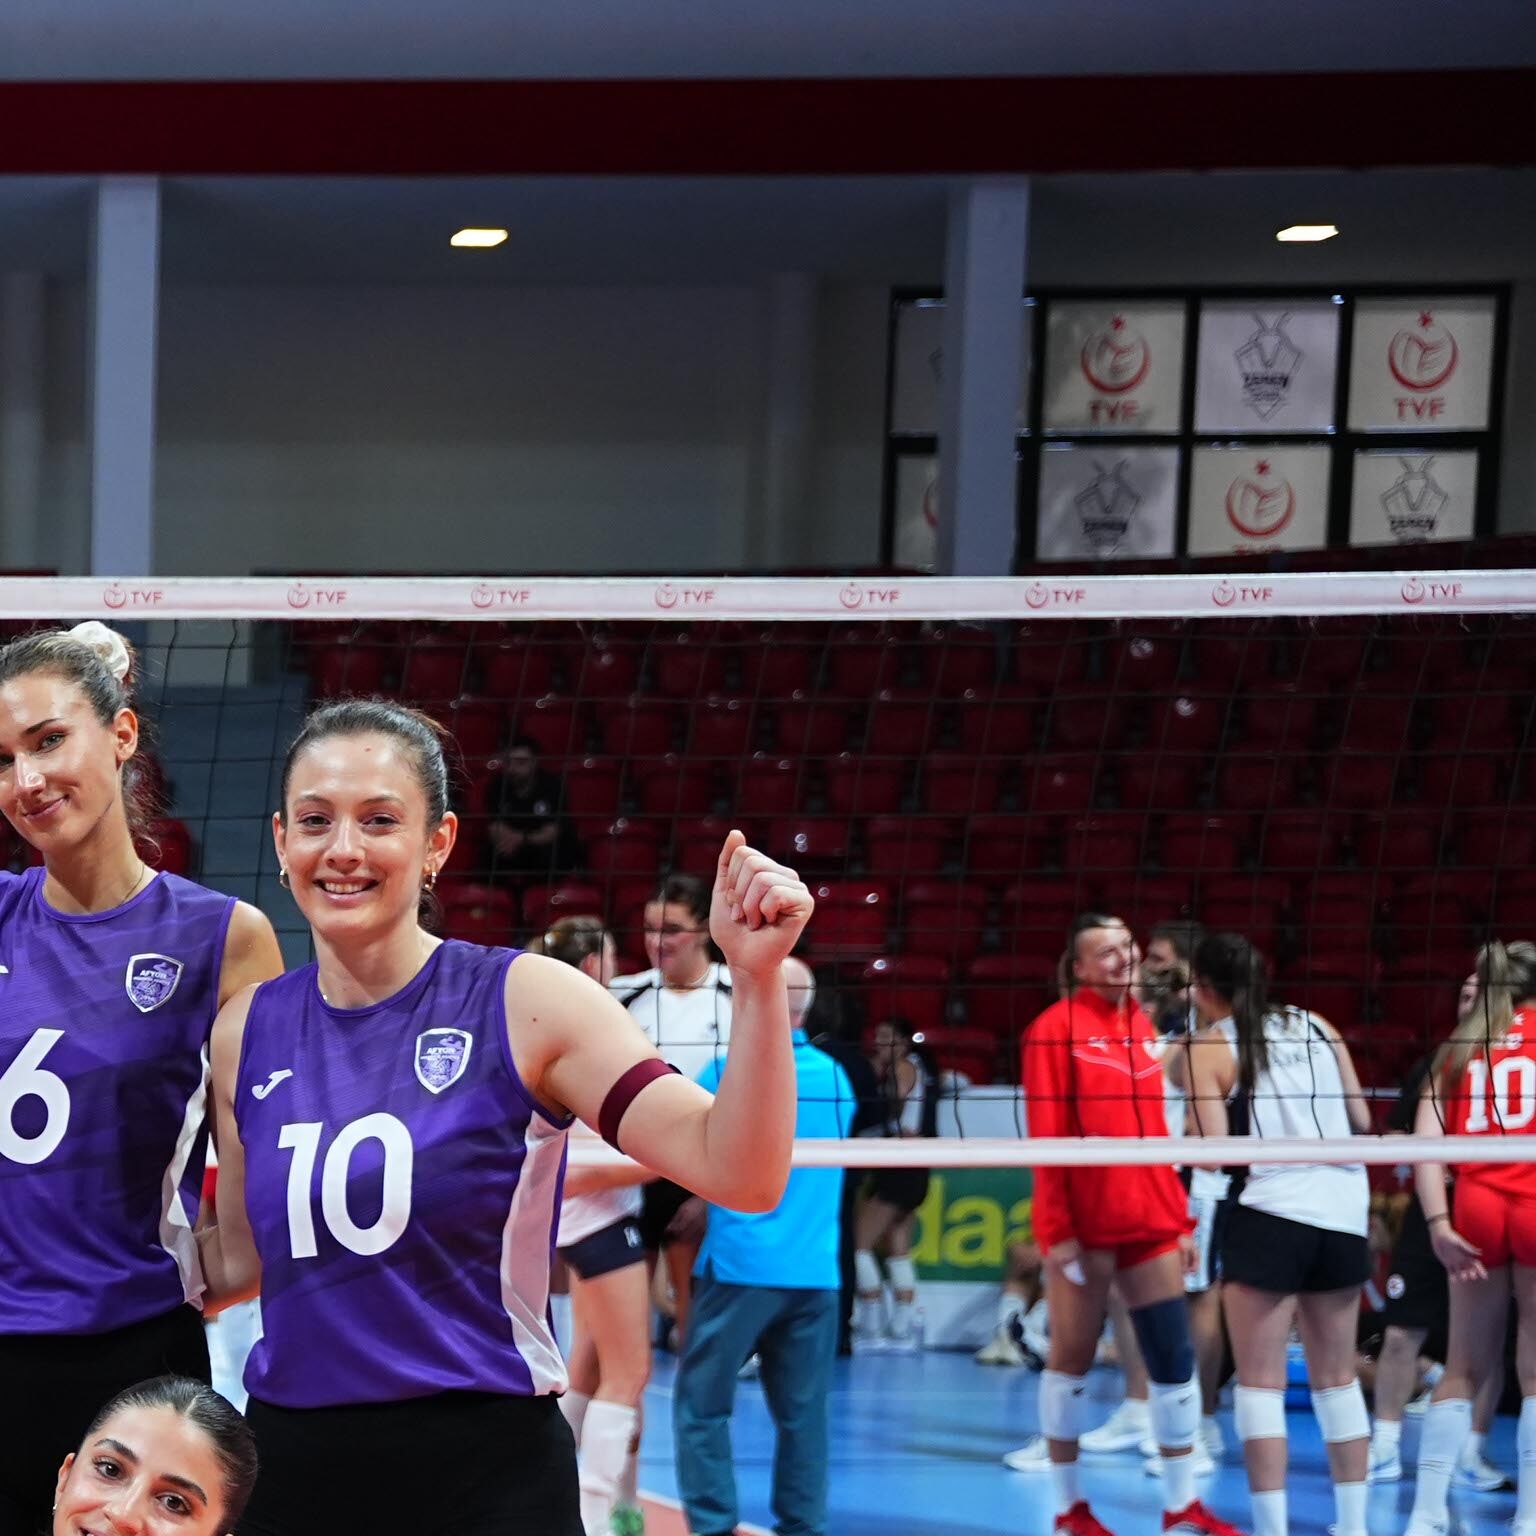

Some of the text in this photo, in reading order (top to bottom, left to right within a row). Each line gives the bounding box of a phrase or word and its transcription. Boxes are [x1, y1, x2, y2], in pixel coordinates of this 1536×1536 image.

[1089, 400, 1139, 422] TVF
[1394, 398, 1446, 421] TVF
[130, 591, 164, 605] TVF
[314, 591, 348, 605] TVF
[497, 591, 531, 605] TVF
[682, 590, 716, 604] TVF
[867, 590, 900, 604] TVF
[1052, 590, 1086, 604] TVF
[1240, 588, 1273, 602] TVF
[1428, 585, 1462, 599] TVF
[1465, 1056, 1536, 1134] 10
[277, 1112, 414, 1259] 10
